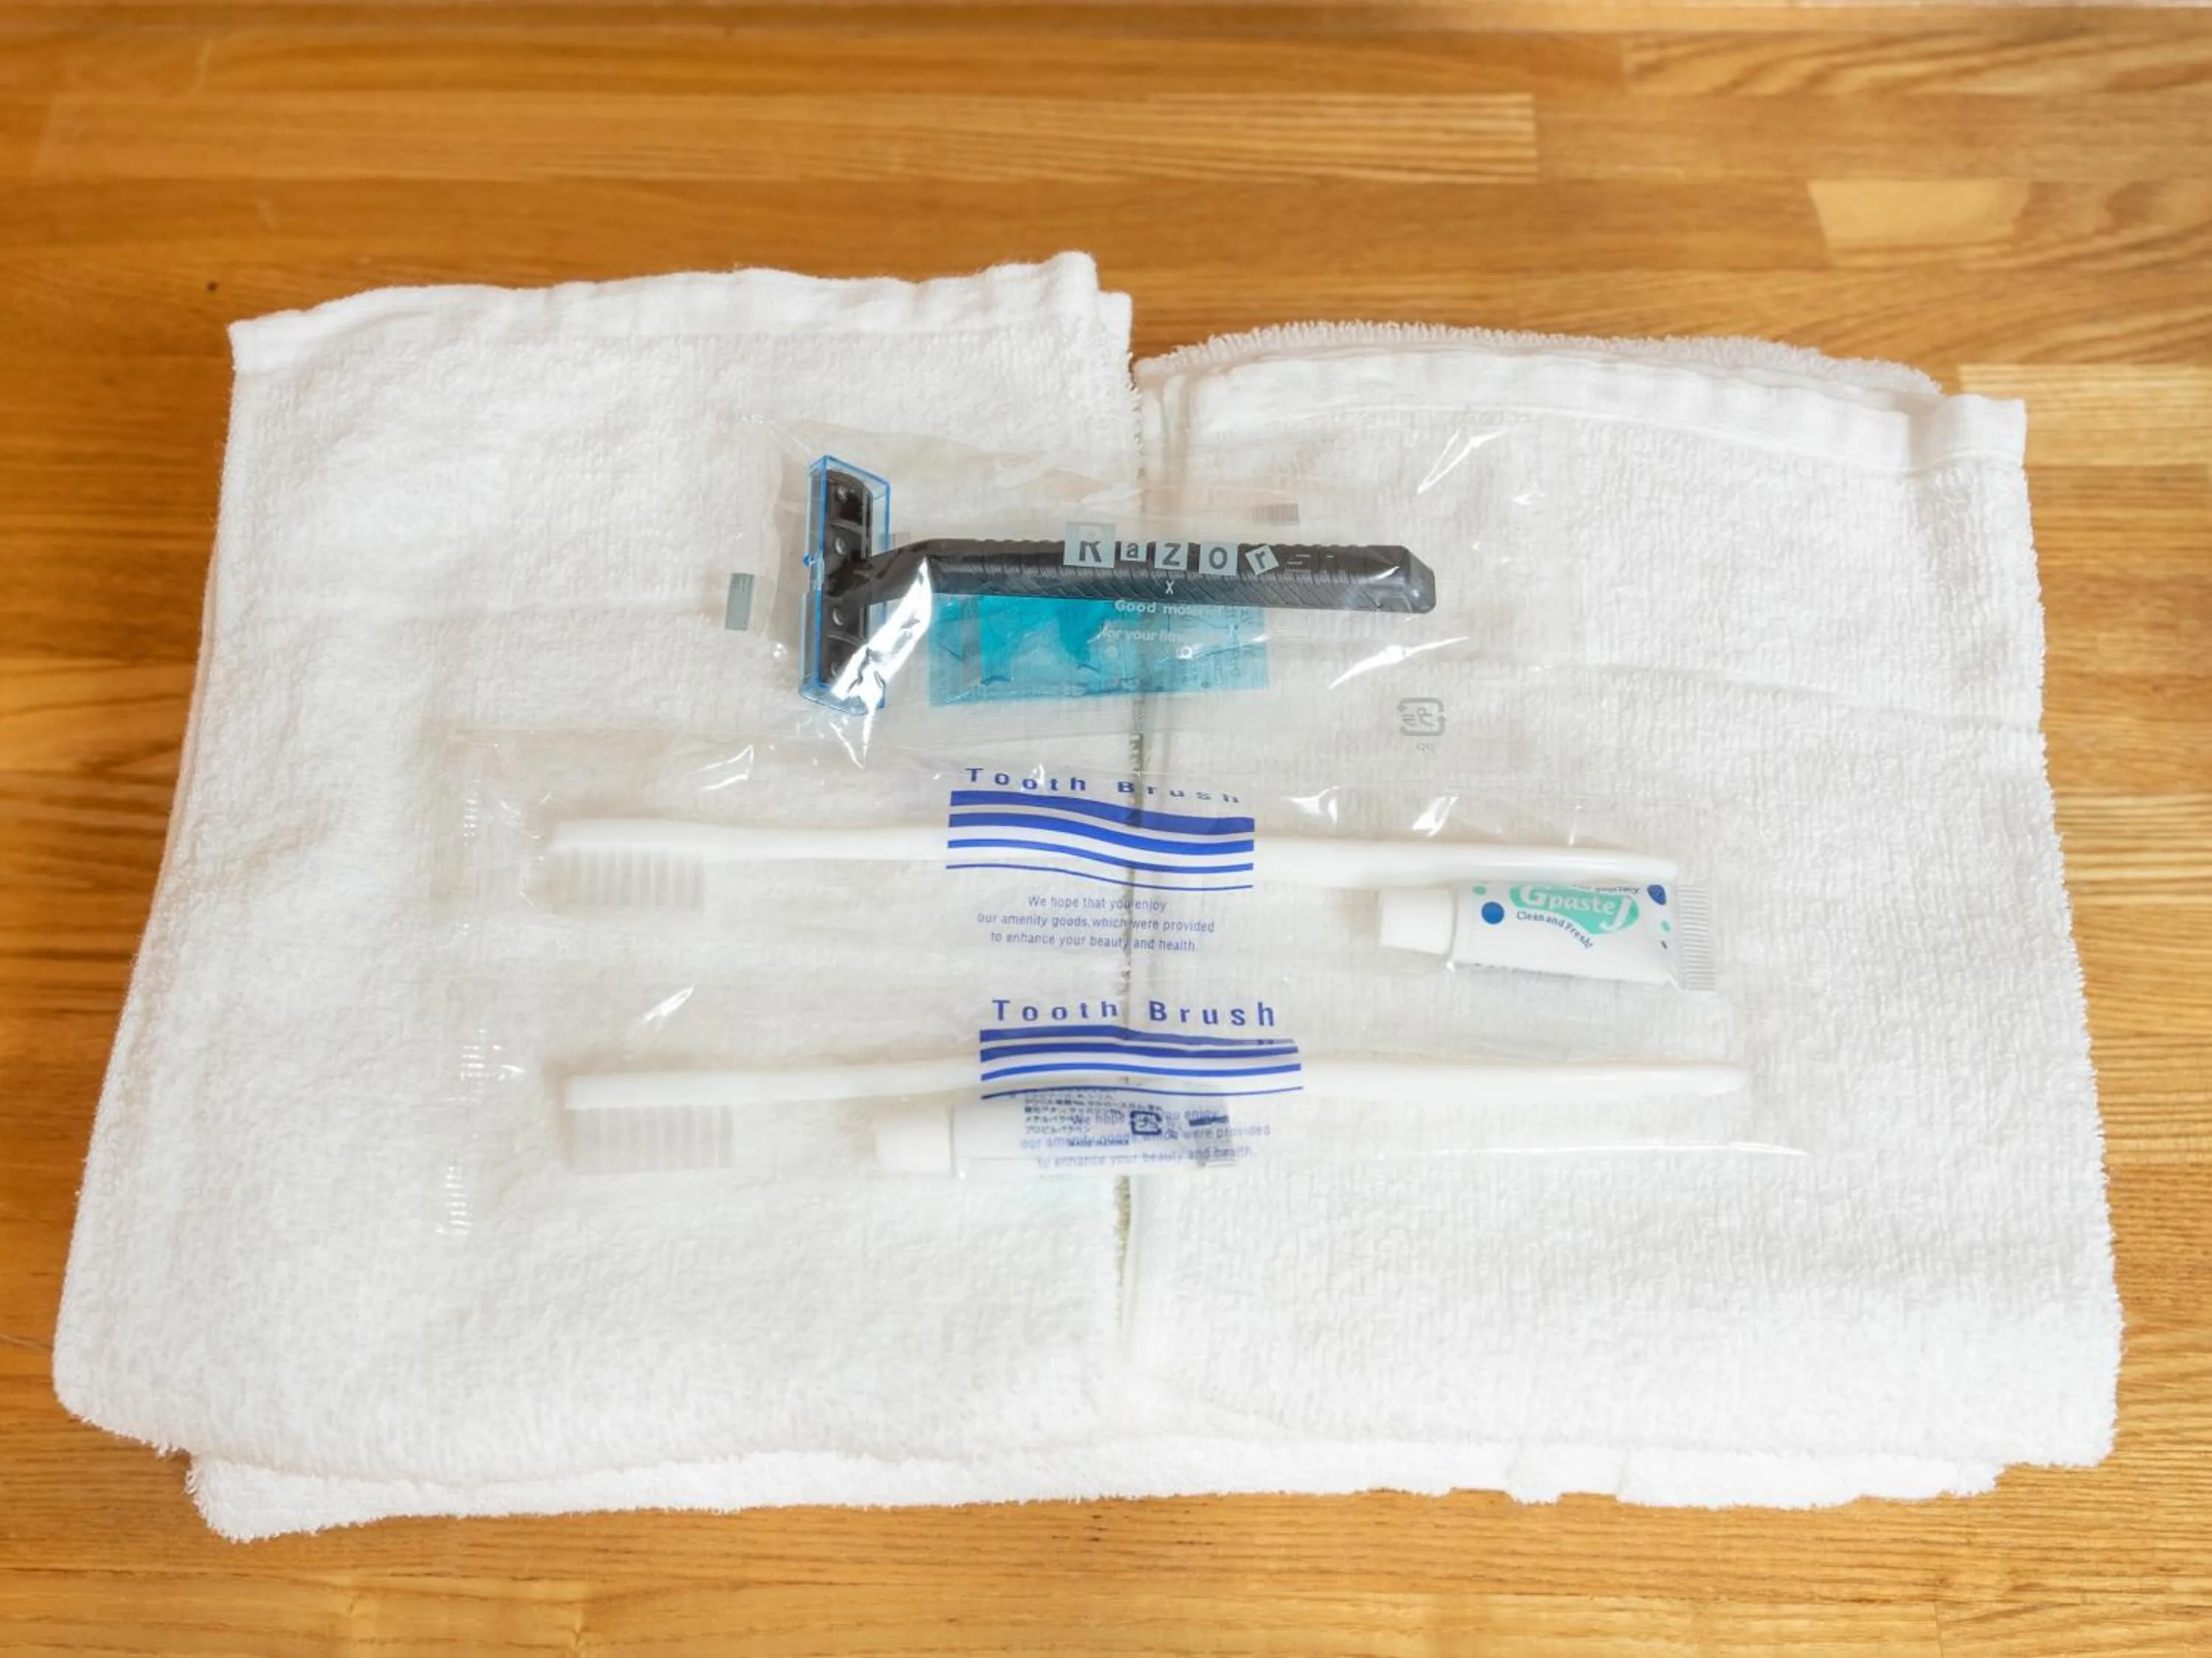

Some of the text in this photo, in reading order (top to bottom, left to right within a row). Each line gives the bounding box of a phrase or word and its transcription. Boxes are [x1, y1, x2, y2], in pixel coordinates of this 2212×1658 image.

[1114, 600, 1157, 614] Good
[966, 768, 1240, 804] Tooth Brush
[1028, 895, 1167, 913] We hope that you enjoy
[977, 912, 997, 923] our
[1001, 914, 1048, 927] amenity
[1131, 919, 1160, 930] were
[1163, 920, 1215, 933] provided
[1516, 910, 1545, 922] Clean
[1545, 914, 1565, 928] and
[990, 932, 1003, 943] to
[1006, 932, 1055, 945] enhance
[1058, 935, 1085, 948] your
[1089, 935, 1128, 951] beauty
[1133, 937, 1155, 951] and
[992, 999, 1276, 1027] Tooth Brush
